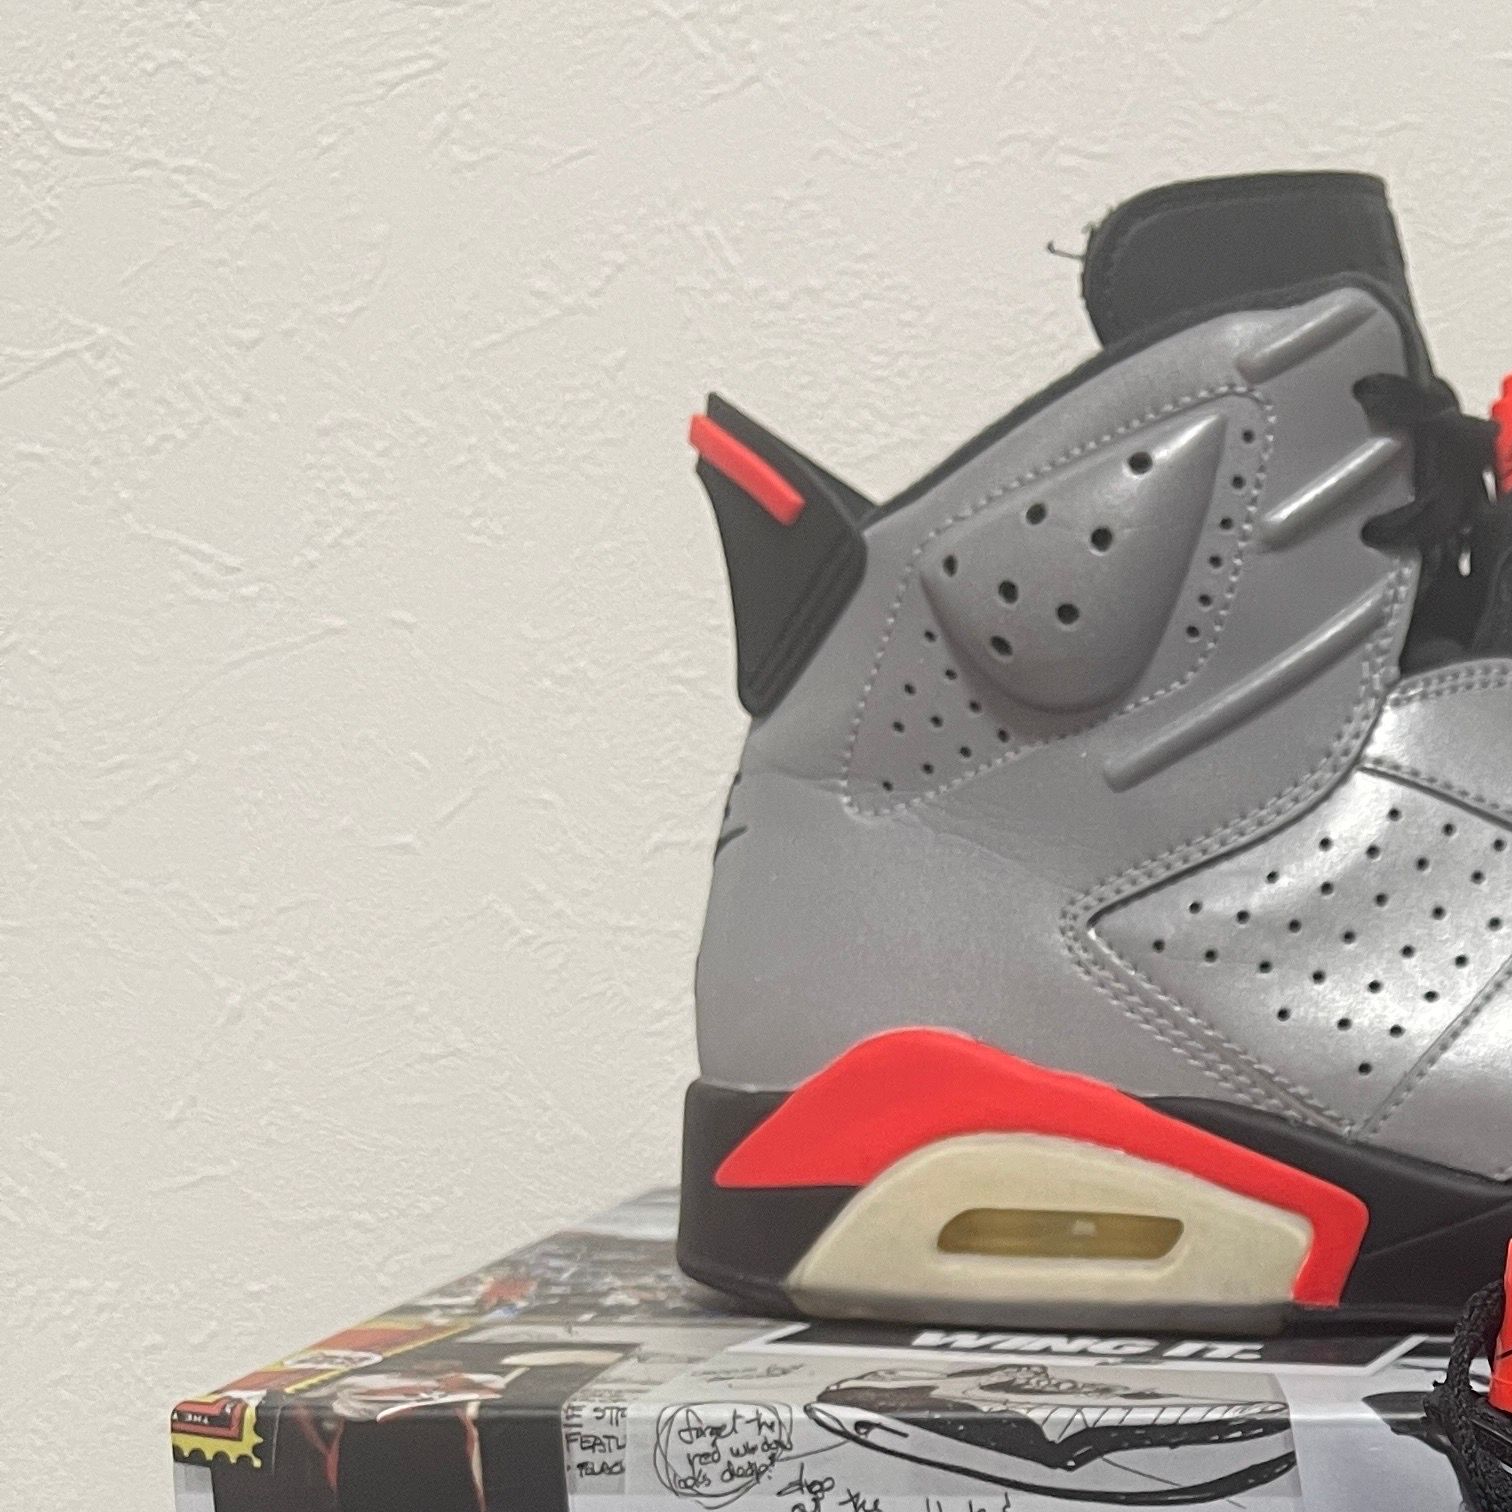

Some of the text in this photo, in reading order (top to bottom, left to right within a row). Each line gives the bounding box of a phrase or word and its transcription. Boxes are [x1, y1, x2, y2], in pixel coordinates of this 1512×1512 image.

[911, 1330, 1265, 1360] WING IT.
[687, 1437, 721, 1477] red
